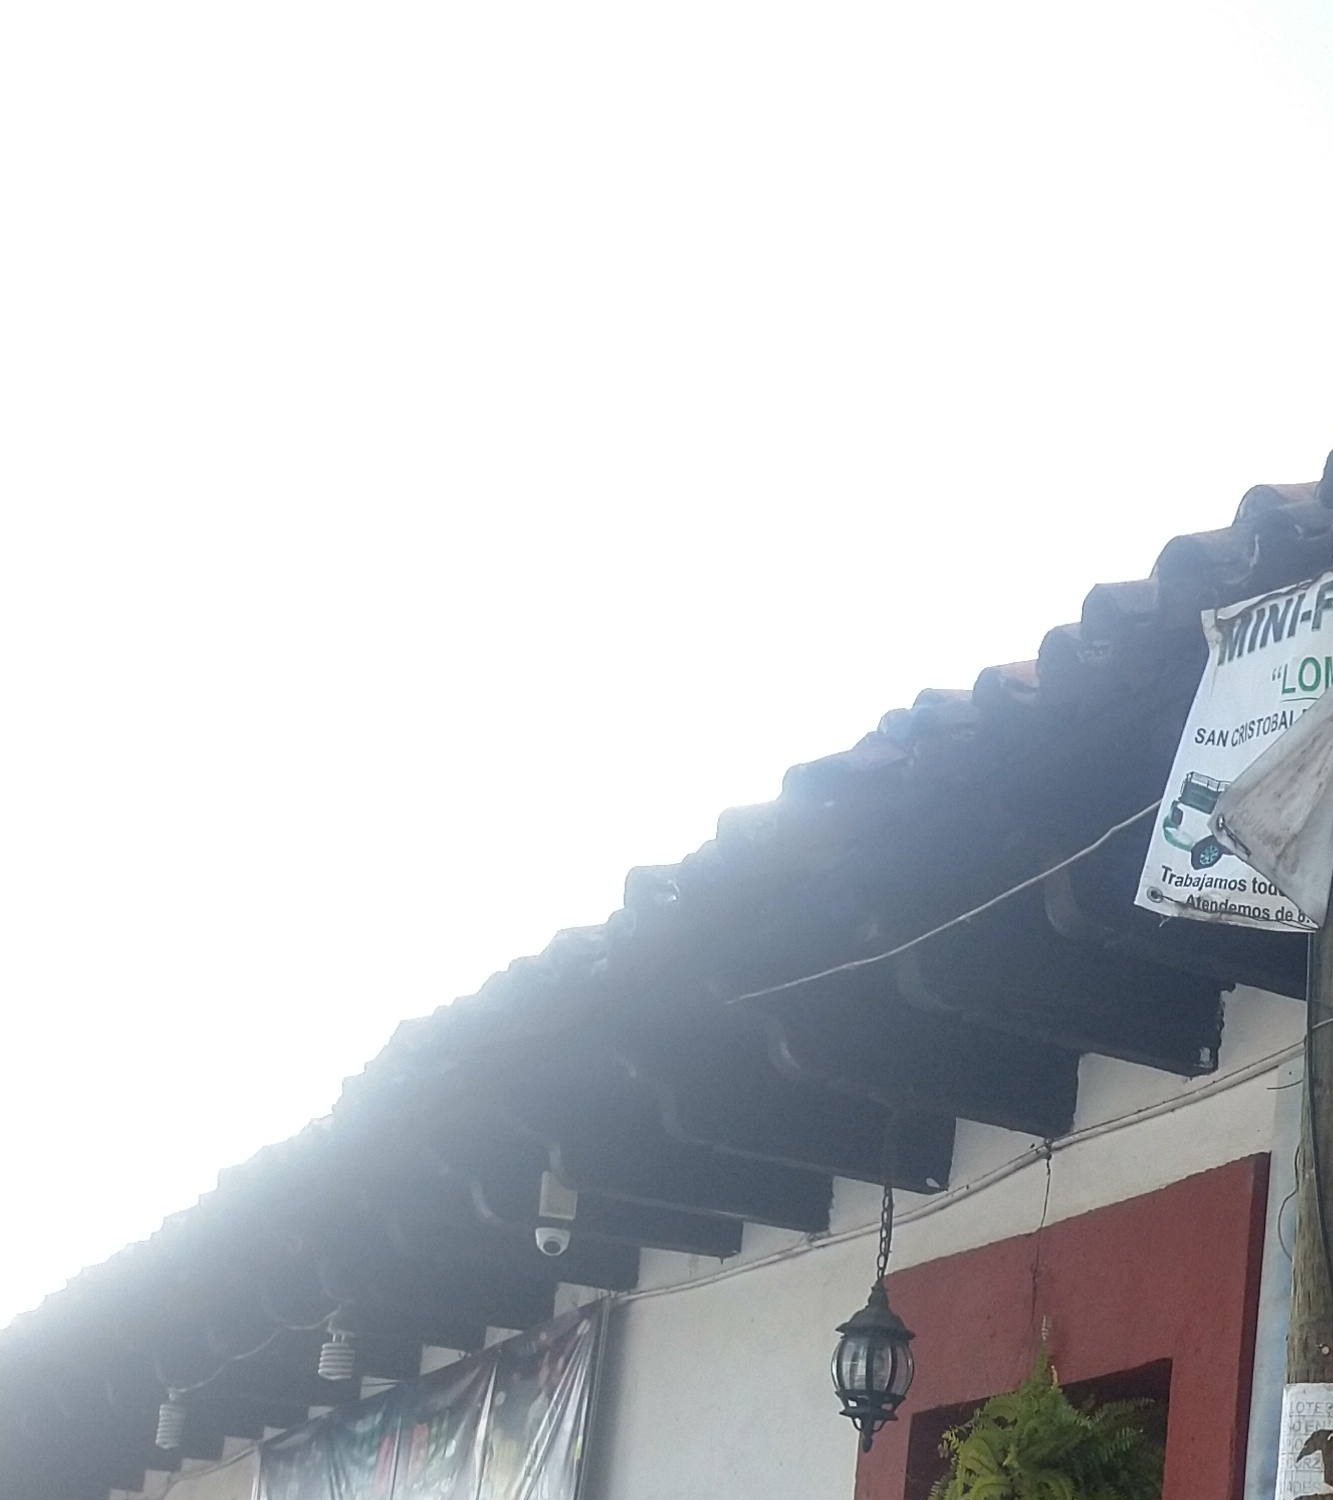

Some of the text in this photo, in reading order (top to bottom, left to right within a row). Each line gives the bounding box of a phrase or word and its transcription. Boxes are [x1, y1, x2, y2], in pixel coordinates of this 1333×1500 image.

[1195, 727, 1229, 748] SAN
[1161, 865, 1247, 892] Trabajamos
[1186, 894, 1271, 920] Atendemos
[1275, 906, 1293, 922] de
